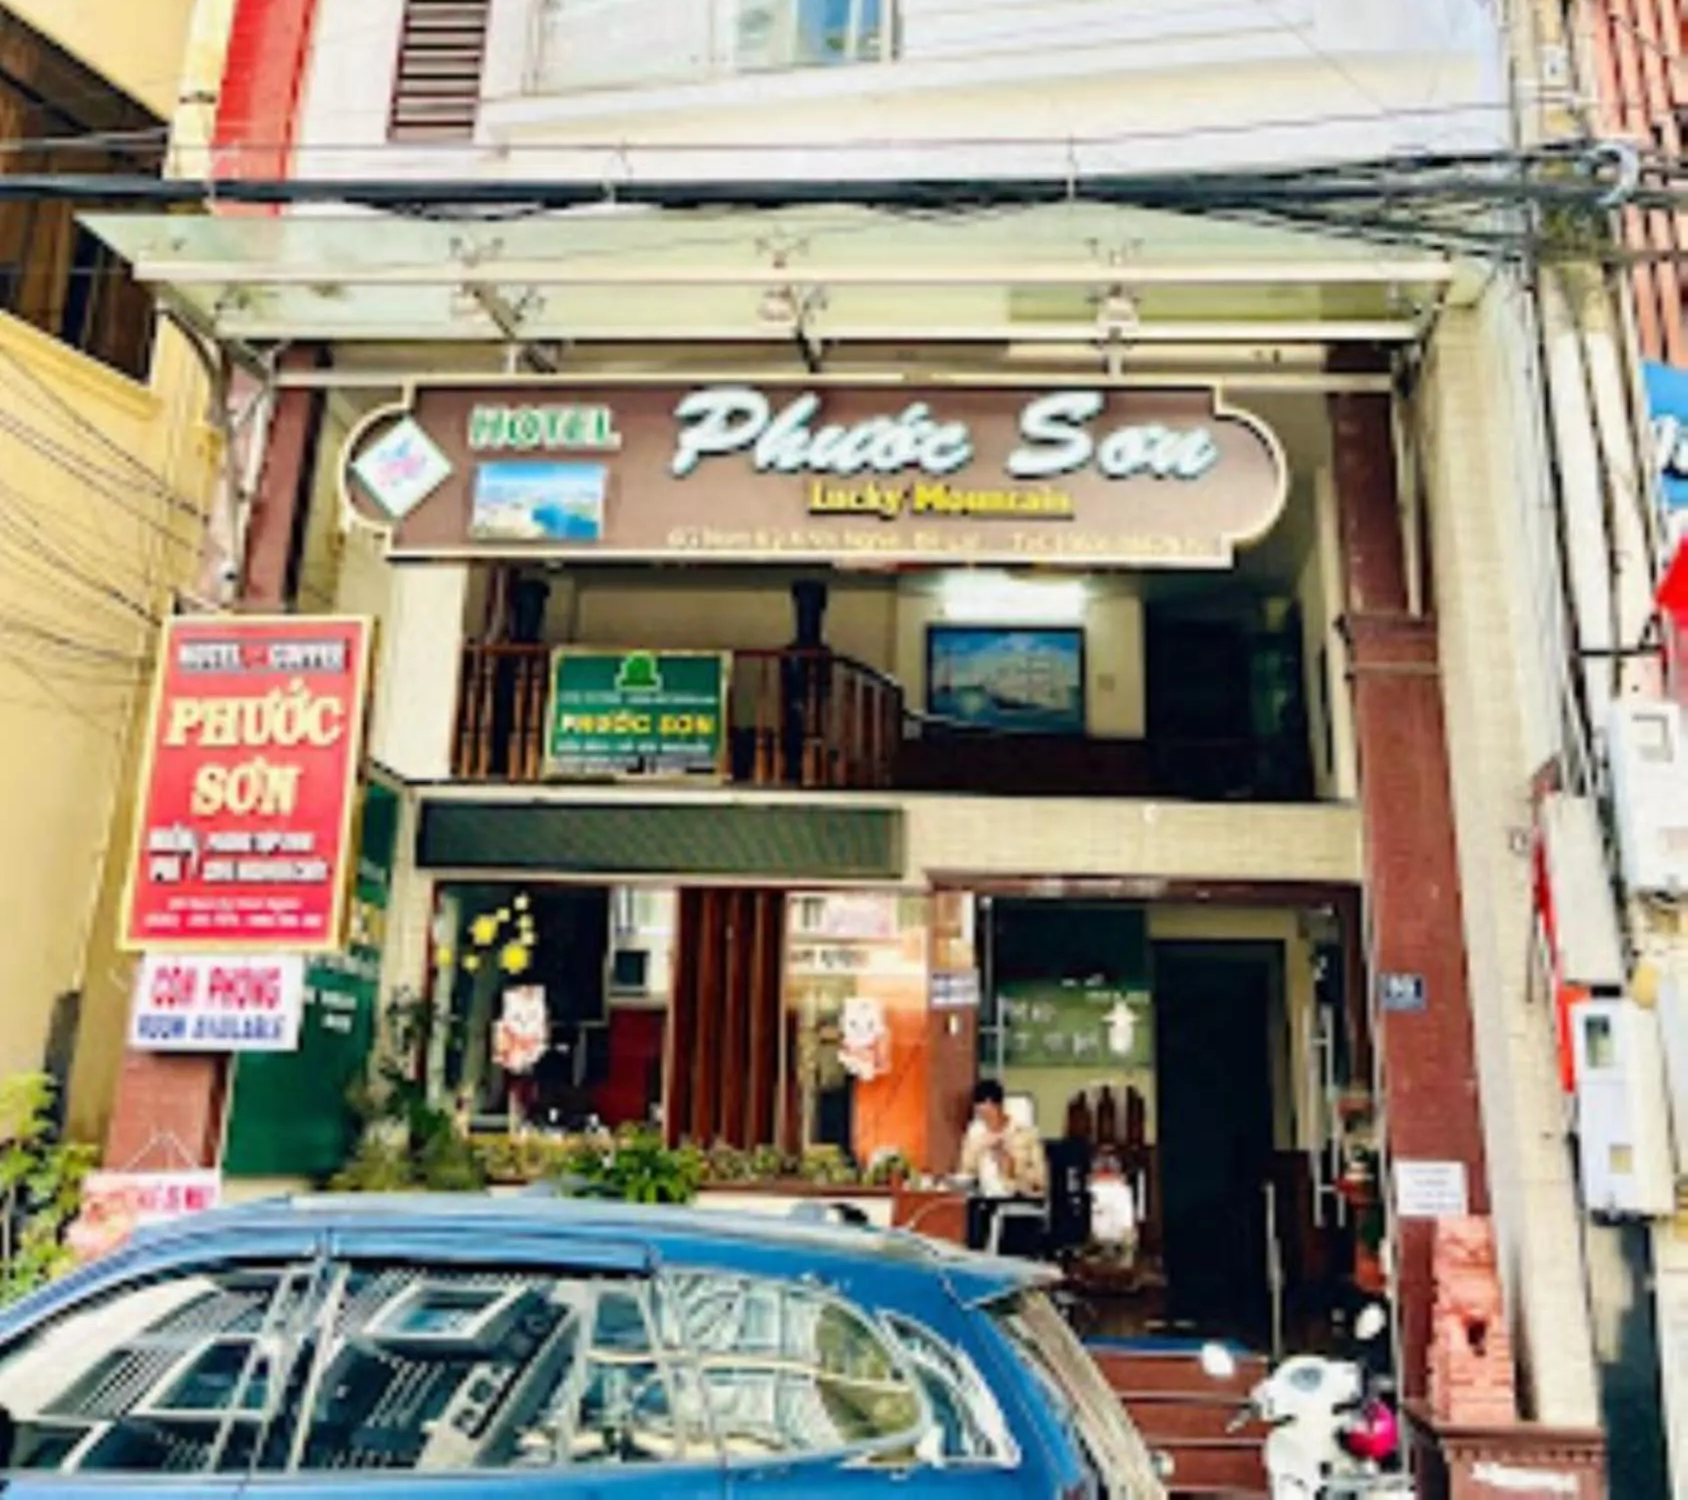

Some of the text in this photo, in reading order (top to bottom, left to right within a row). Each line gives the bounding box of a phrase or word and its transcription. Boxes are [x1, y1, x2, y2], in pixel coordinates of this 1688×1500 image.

[468, 402, 622, 450] HOTEL
[810, 480, 1074, 517] Lucky Mountain
[164, 677, 345, 745] PHƯỚC
[191, 755, 301, 815] SƠN
